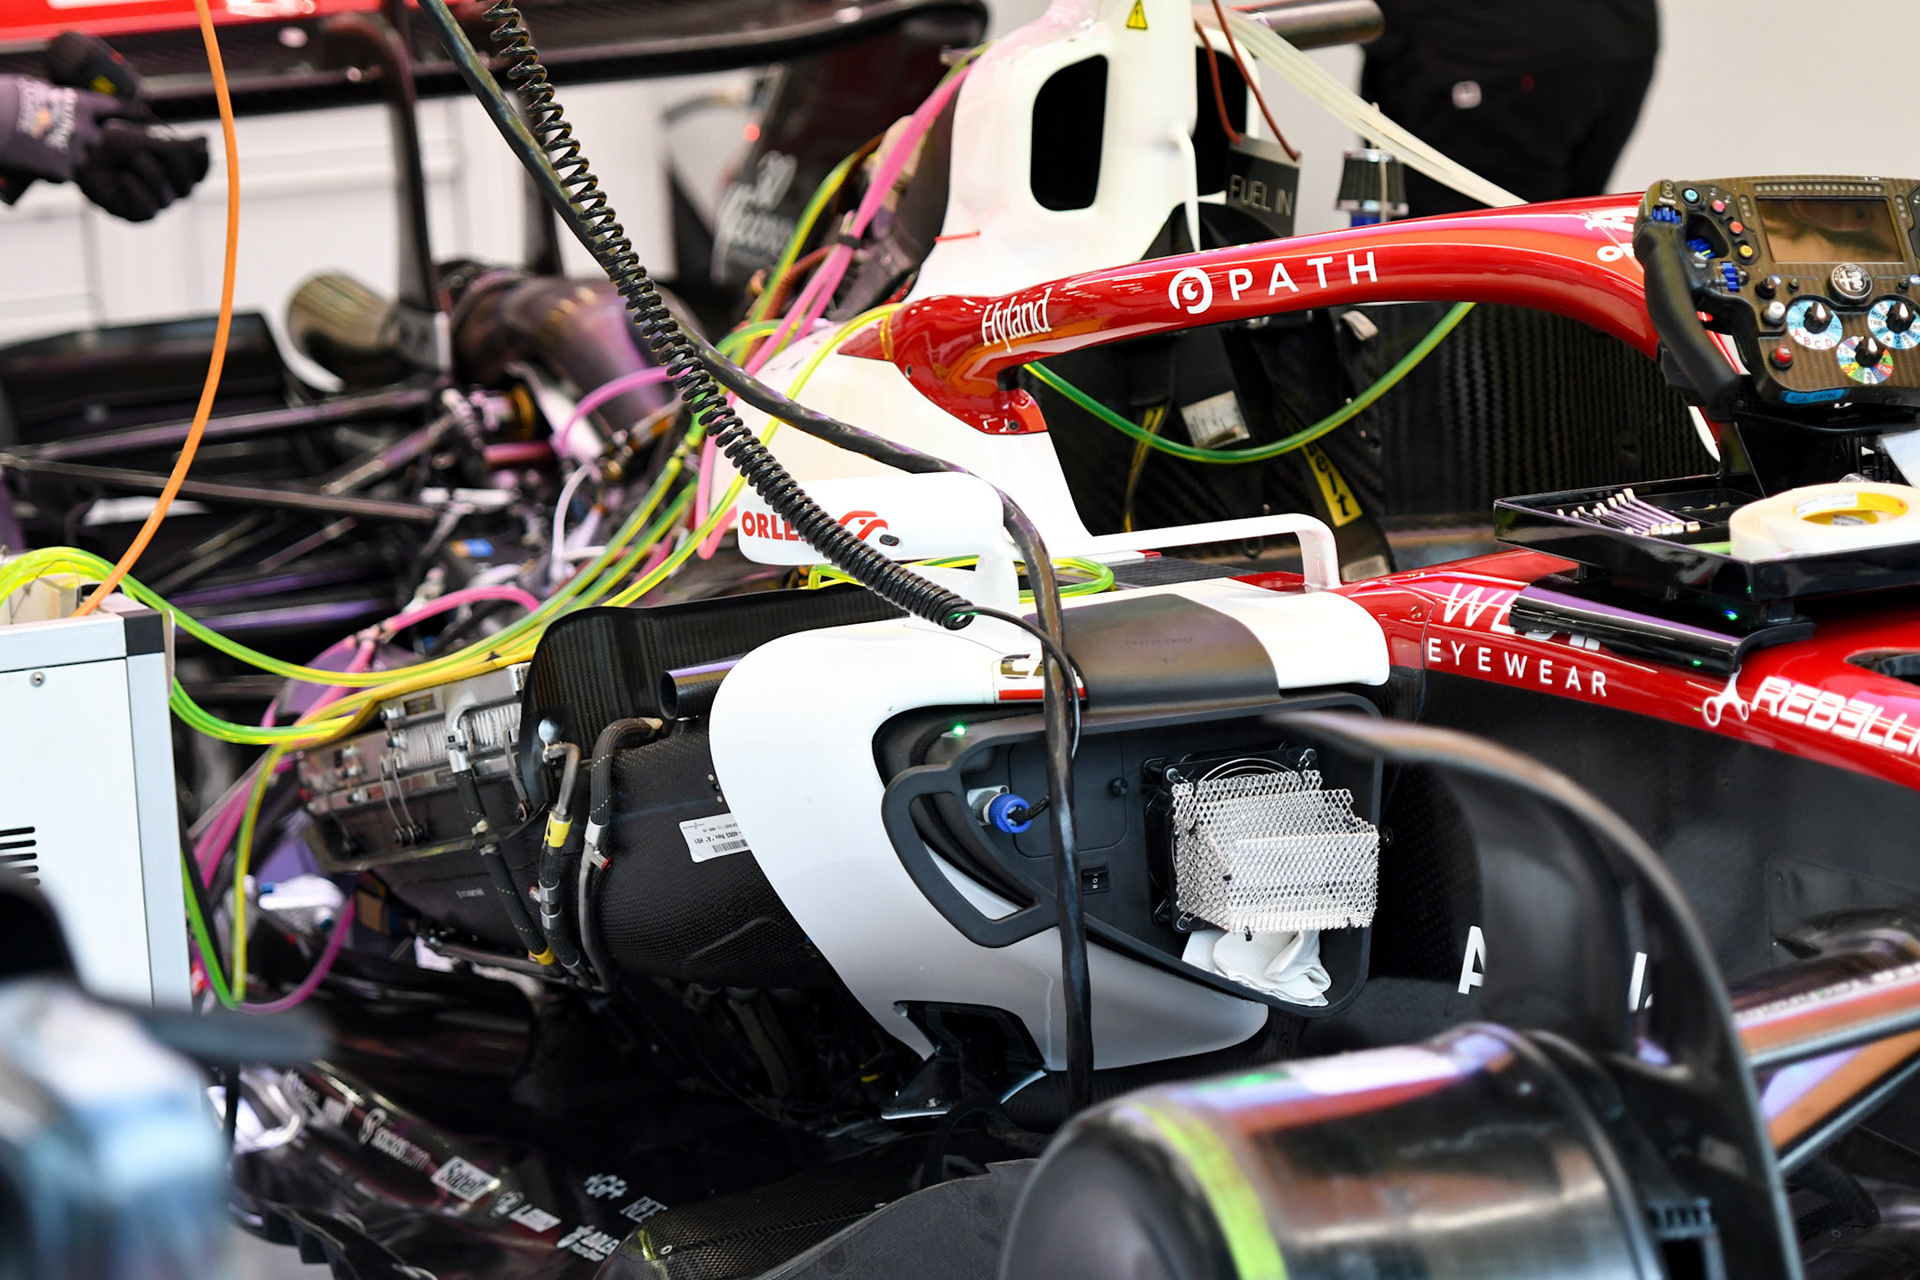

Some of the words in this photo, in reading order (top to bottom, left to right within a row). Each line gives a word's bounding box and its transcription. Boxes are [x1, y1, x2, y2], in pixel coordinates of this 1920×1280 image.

[1229, 174, 1272, 212] FUEL
[1275, 188, 1294, 217] IN
[1229, 251, 1378, 301] PATH
[982, 287, 1053, 353] Hyland
[1877, 364, 1893, 376] END
[742, 511, 807, 541] ORLE
[1428, 637, 1607, 697] EYEWEAR
